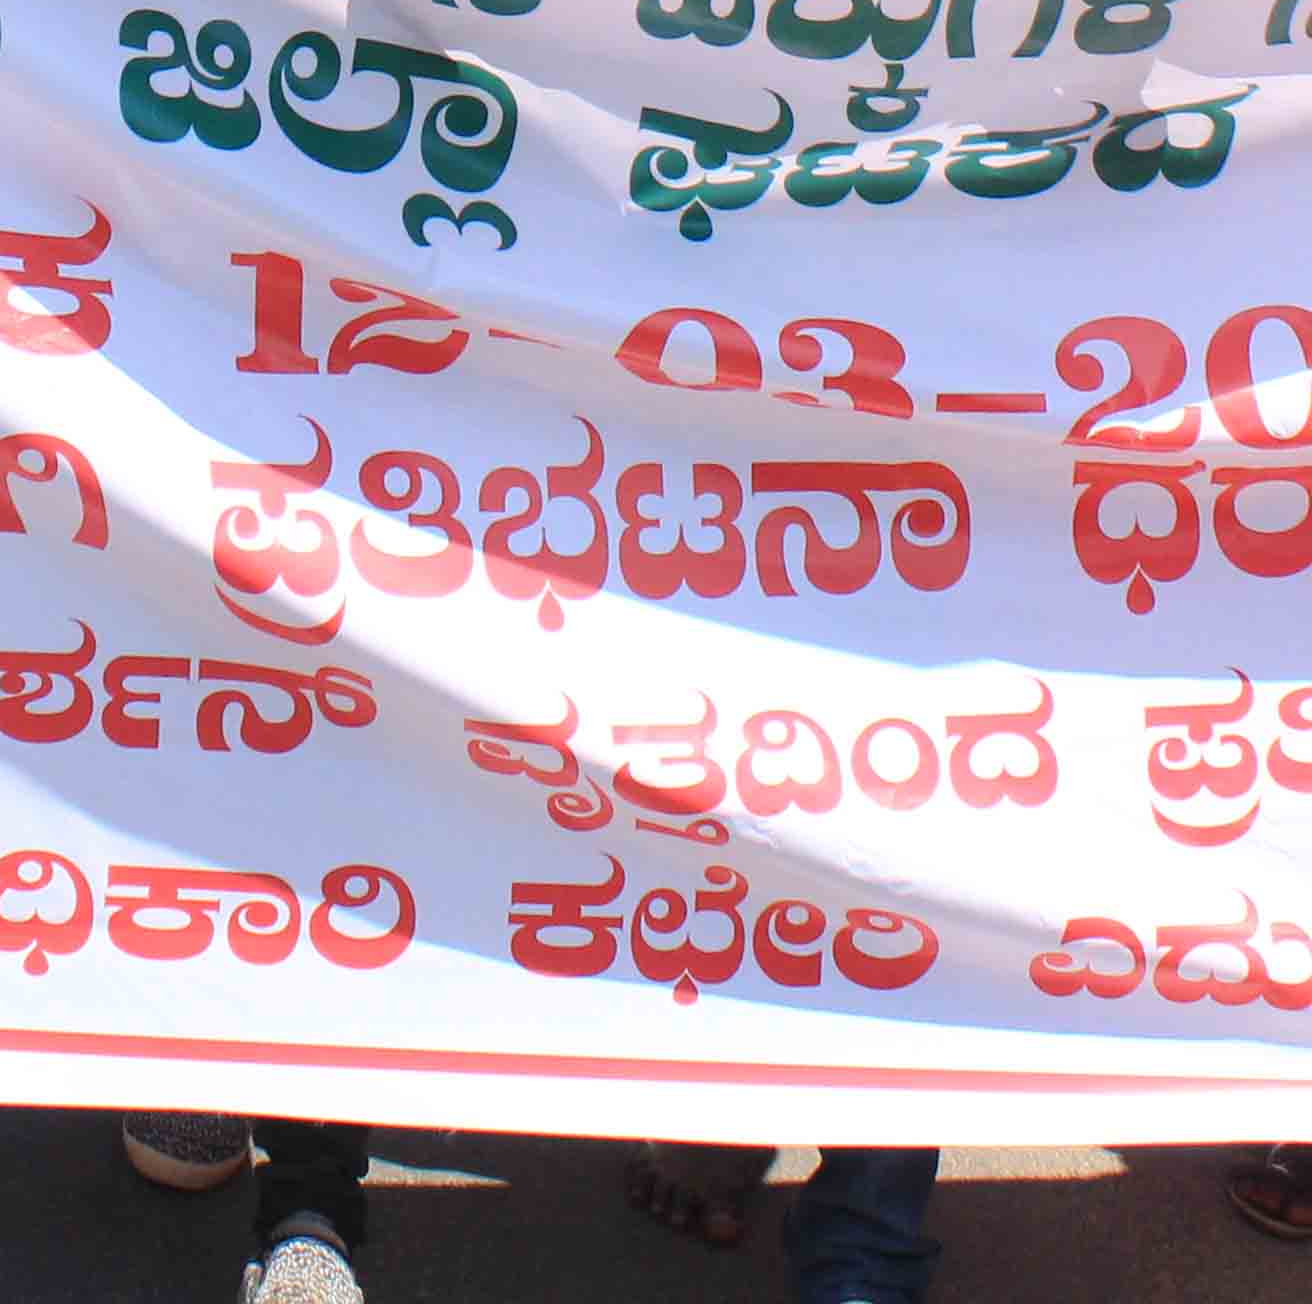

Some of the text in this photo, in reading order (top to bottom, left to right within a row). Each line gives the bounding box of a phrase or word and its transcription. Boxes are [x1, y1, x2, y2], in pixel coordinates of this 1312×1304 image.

[119, 9, 518, 250] ಜಿಲ್ಲಾ
[629, 84, 1261, 242] ಘಟಕದ
[210, 414, 972, 646] ಪ್ರತಿಭಟನಾ
[463, 674, 1059, 845] ವೃತ್ತದಿಂದ
